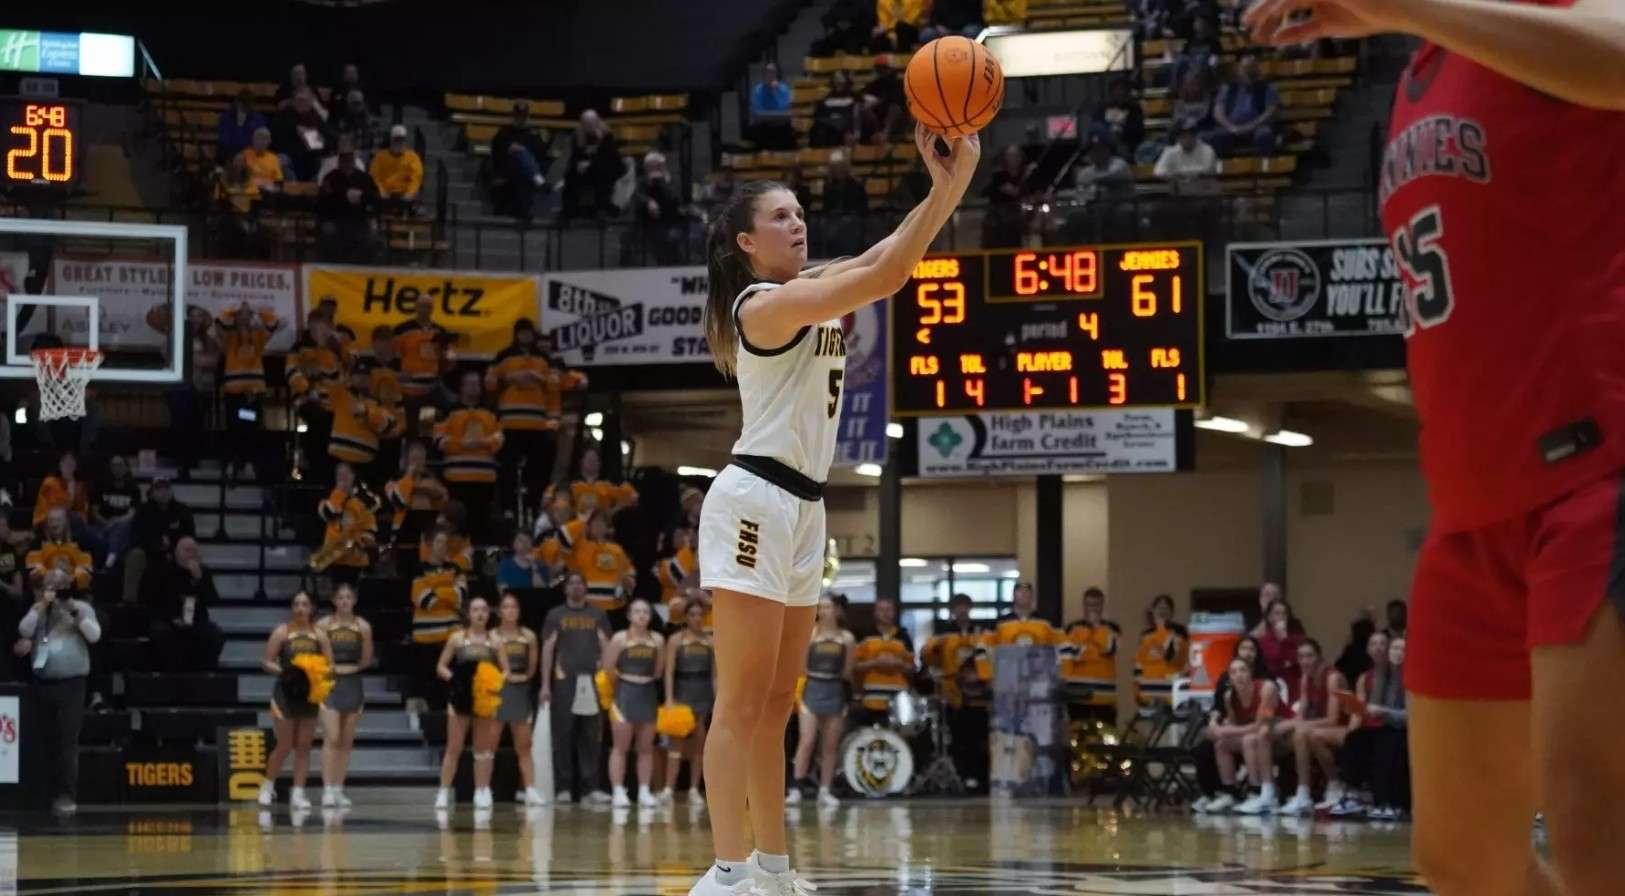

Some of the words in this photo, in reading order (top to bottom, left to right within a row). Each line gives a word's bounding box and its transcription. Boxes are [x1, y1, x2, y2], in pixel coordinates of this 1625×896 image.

[26, 105, 65, 127] 6:48
[7, 126, 72, 182] 20
[1014, 251, 1097, 295] 6:48
[1120, 250, 1180, 271] JENNIES
[1330, 247, 1380, 281] SUBS
[63, 264, 112, 282] GREAT
[120, 267, 168, 284] STYLE
[193, 269, 224, 287] LOW
[558, 285, 596, 315] 8th
[917, 281, 966, 325] 53
[1131, 274, 1181, 318] 61
[1327, 281, 1385, 317] YOU'LL
[558, 308, 636, 349] LIQUOR
[649, 306, 702, 327] GOOD
[1078, 312, 1098, 340] 4
[1021, 320, 1068, 342] period
[910, 355, 939, 375] FLS
[1017, 351, 1072, 372] PLAYER
[1151, 348, 1180, 368] FLS
[826, 368, 843, 418] 5
[936, 379, 944, 407] 1
[965, 379, 984, 406] 4
[1108, 373, 1126, 405] 3
[1177, 373, 1185, 401] 1
[990, 414, 1033, 433] High
[1039, 412, 1094, 430] Plains
[1040, 432, 1096, 450] Credit
[736, 519, 760, 569] FHSU
[126, 762, 193, 786] TIGERS
